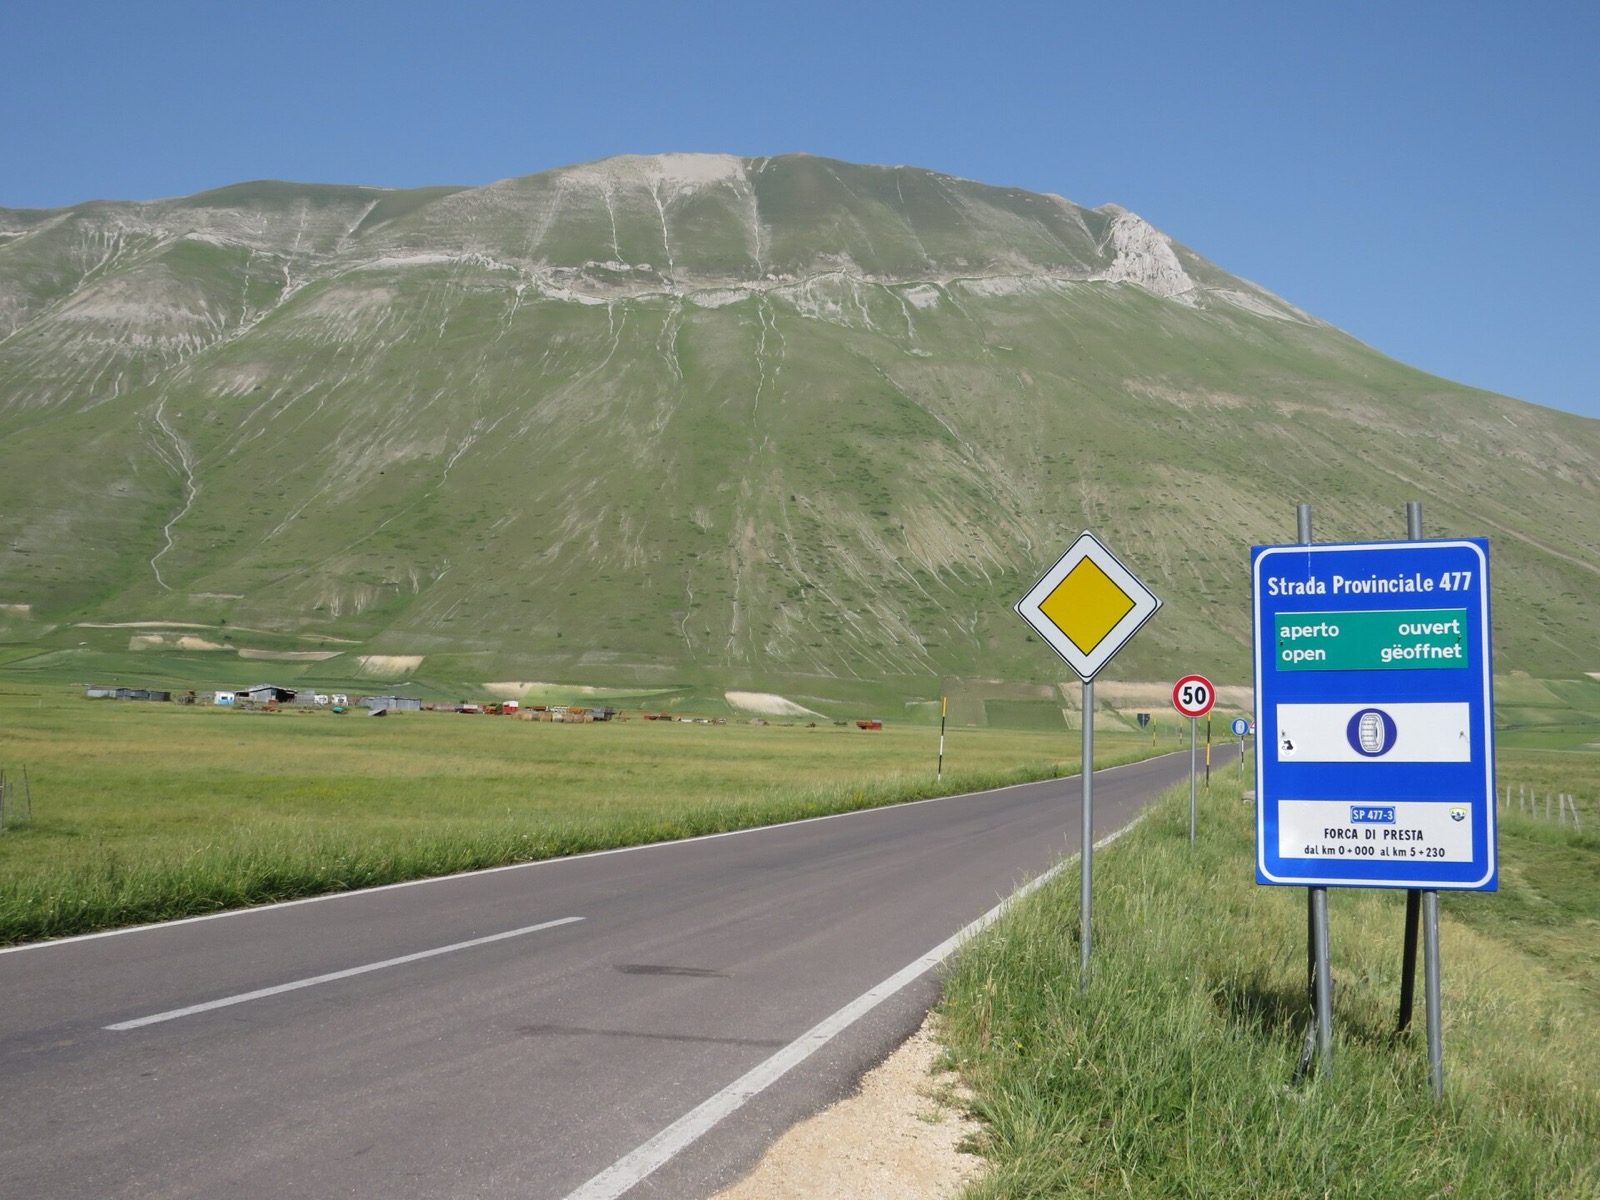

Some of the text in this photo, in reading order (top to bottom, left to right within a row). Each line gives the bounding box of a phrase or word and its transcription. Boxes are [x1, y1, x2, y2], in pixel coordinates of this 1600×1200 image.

[1267, 571, 1472, 596] Strada Provinciale 477
[1279, 622, 1340, 640] aperto
[1398, 619, 1461, 636] ouvert
[1281, 647, 1326, 663] open
[1182, 686, 1207, 705] 50
[1353, 809, 1394, 820] SP 477-3
[1324, 828, 1424, 841] FORCA DI PRESTA
[1304, 844, 1319, 855] dal
[1321, 845, 1336, 855] km
[1380, 846, 1390, 857] al
[1392, 846, 1407, 857] km
